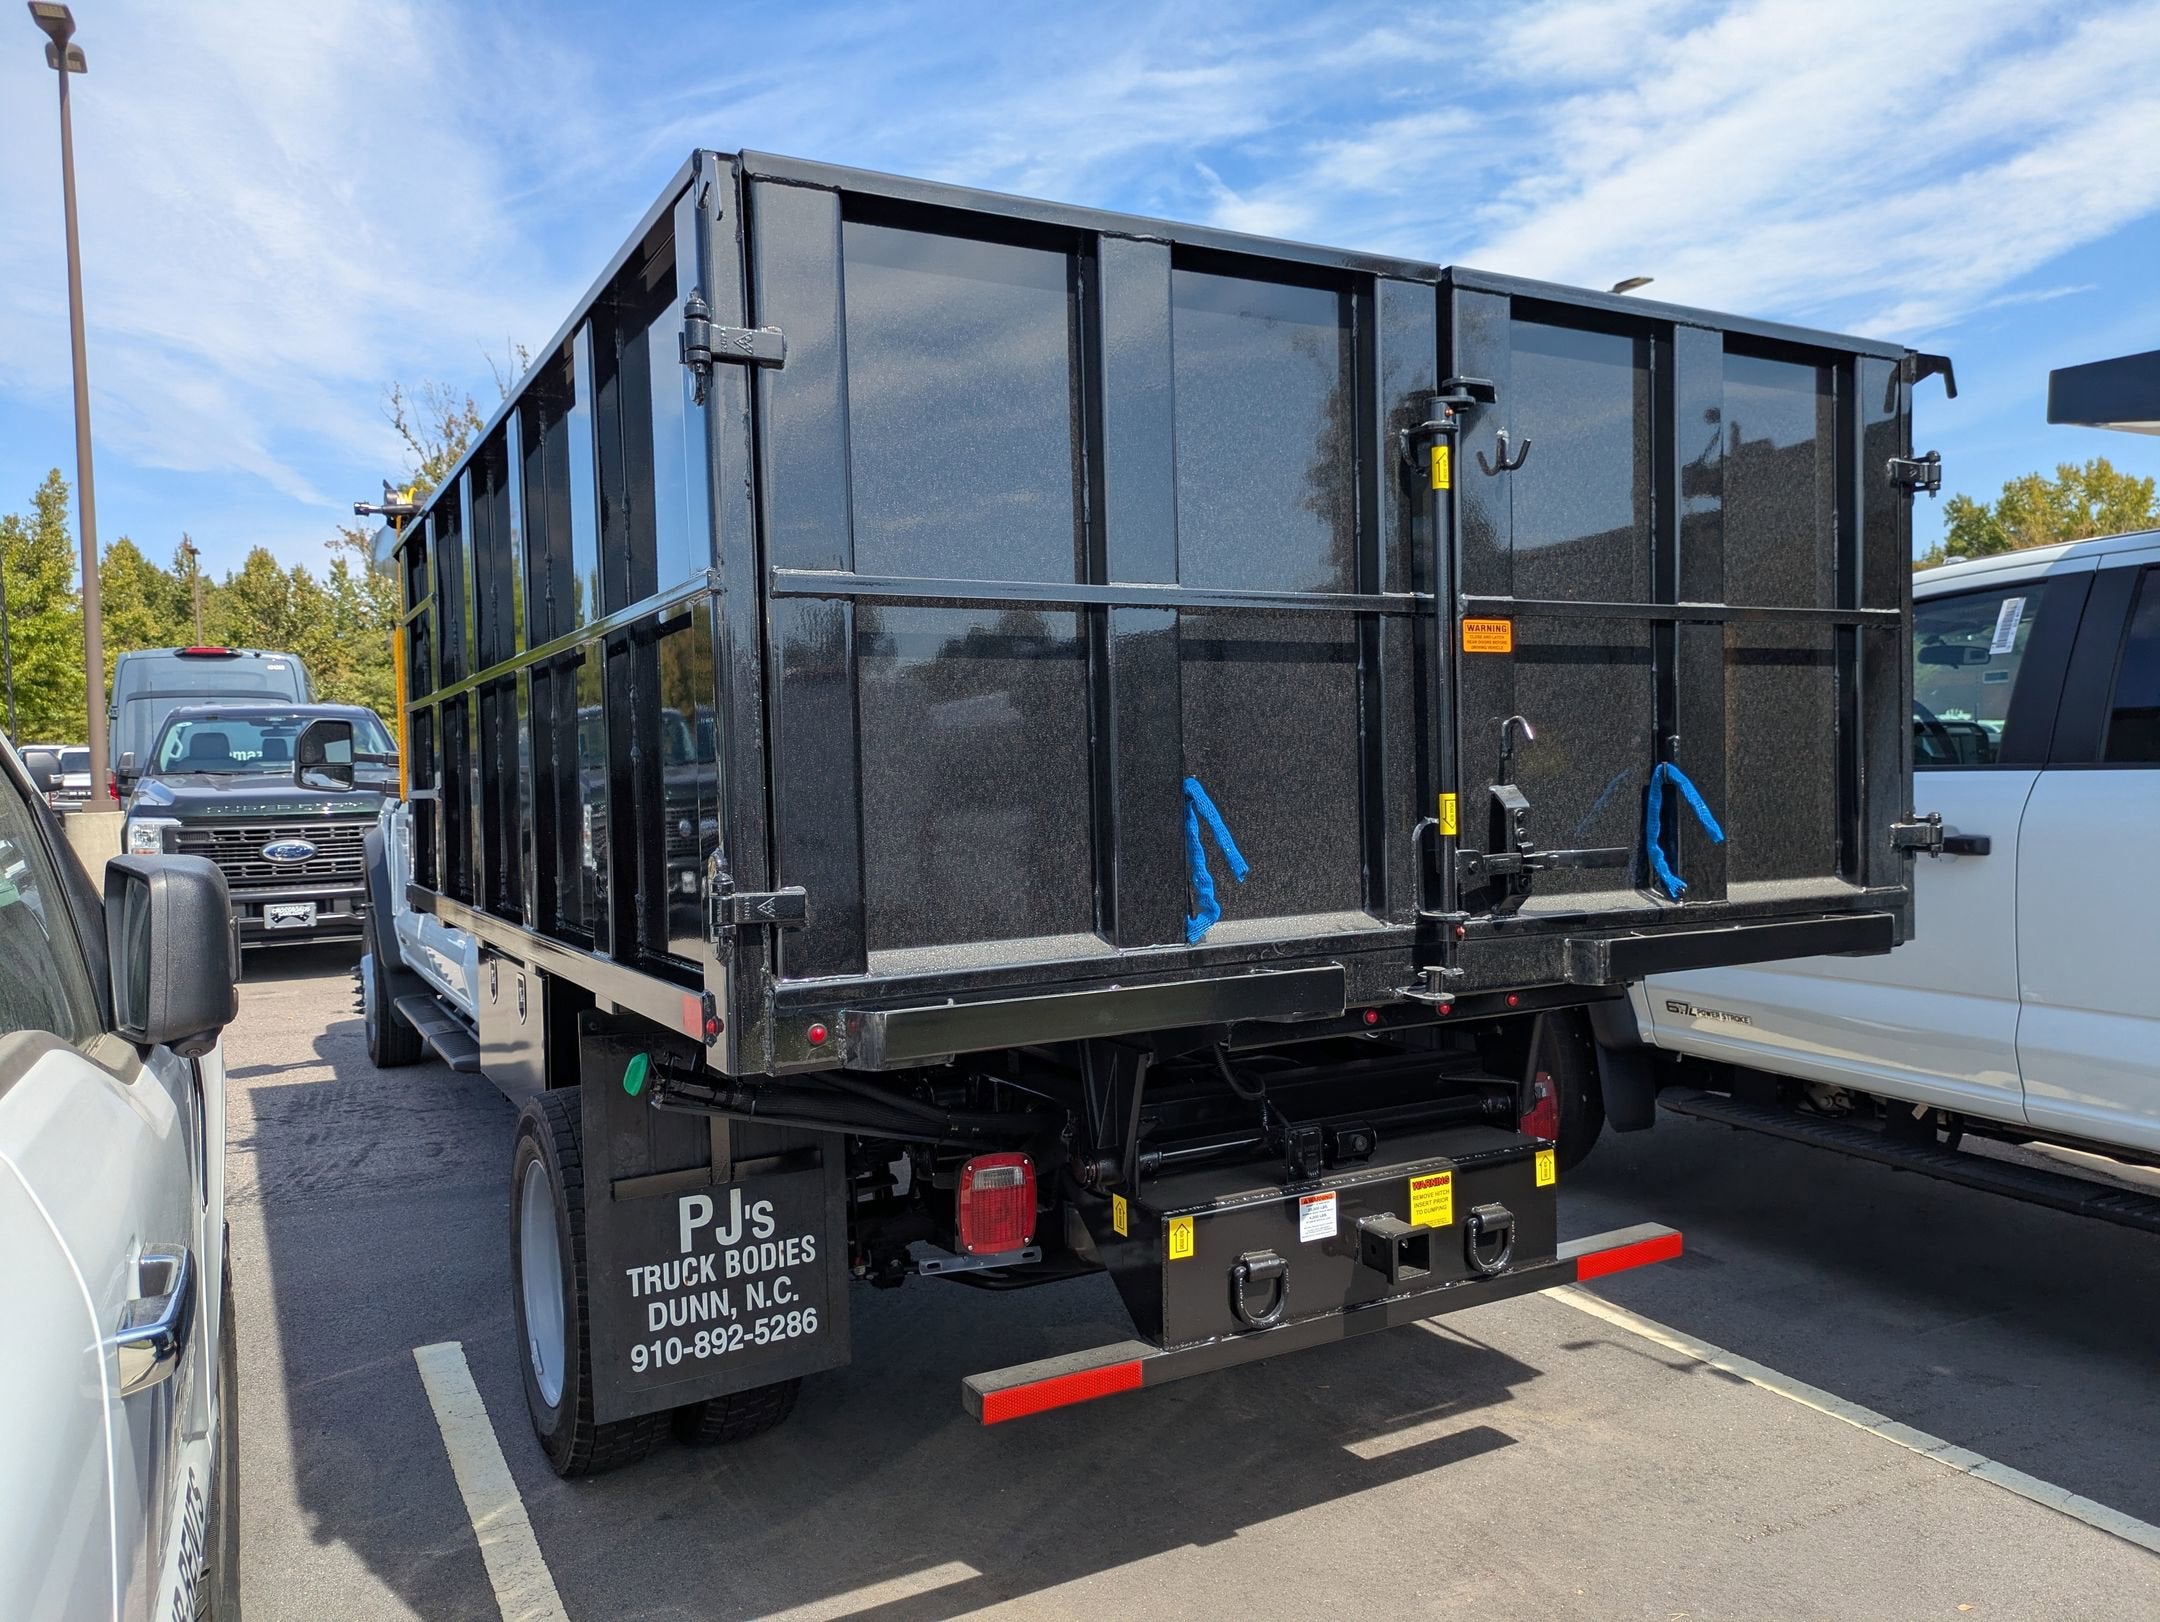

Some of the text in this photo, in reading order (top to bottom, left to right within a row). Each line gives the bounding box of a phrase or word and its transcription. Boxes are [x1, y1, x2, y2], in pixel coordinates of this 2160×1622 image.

[1466, 624, 1507, 633] WARNING
[1697, 1008, 1720, 1019] POWER
[1721, 1013, 1749, 1024] STROKE
[1412, 1175, 1449, 1190] WARNING
[1413, 1189, 1450, 1200] REMOVE HITCH
[1414, 1197, 1449, 1208] INSERT PRIOR
[1424, 1205, 1448, 1214] DUMPING
[679, 1188, 775, 1253] PJ's
[626, 1235, 816, 1297] TRUCK BODIES
[648, 1276, 799, 1332] DUNN, N.C.
[630, 1307, 818, 1373] 910-892-5286
